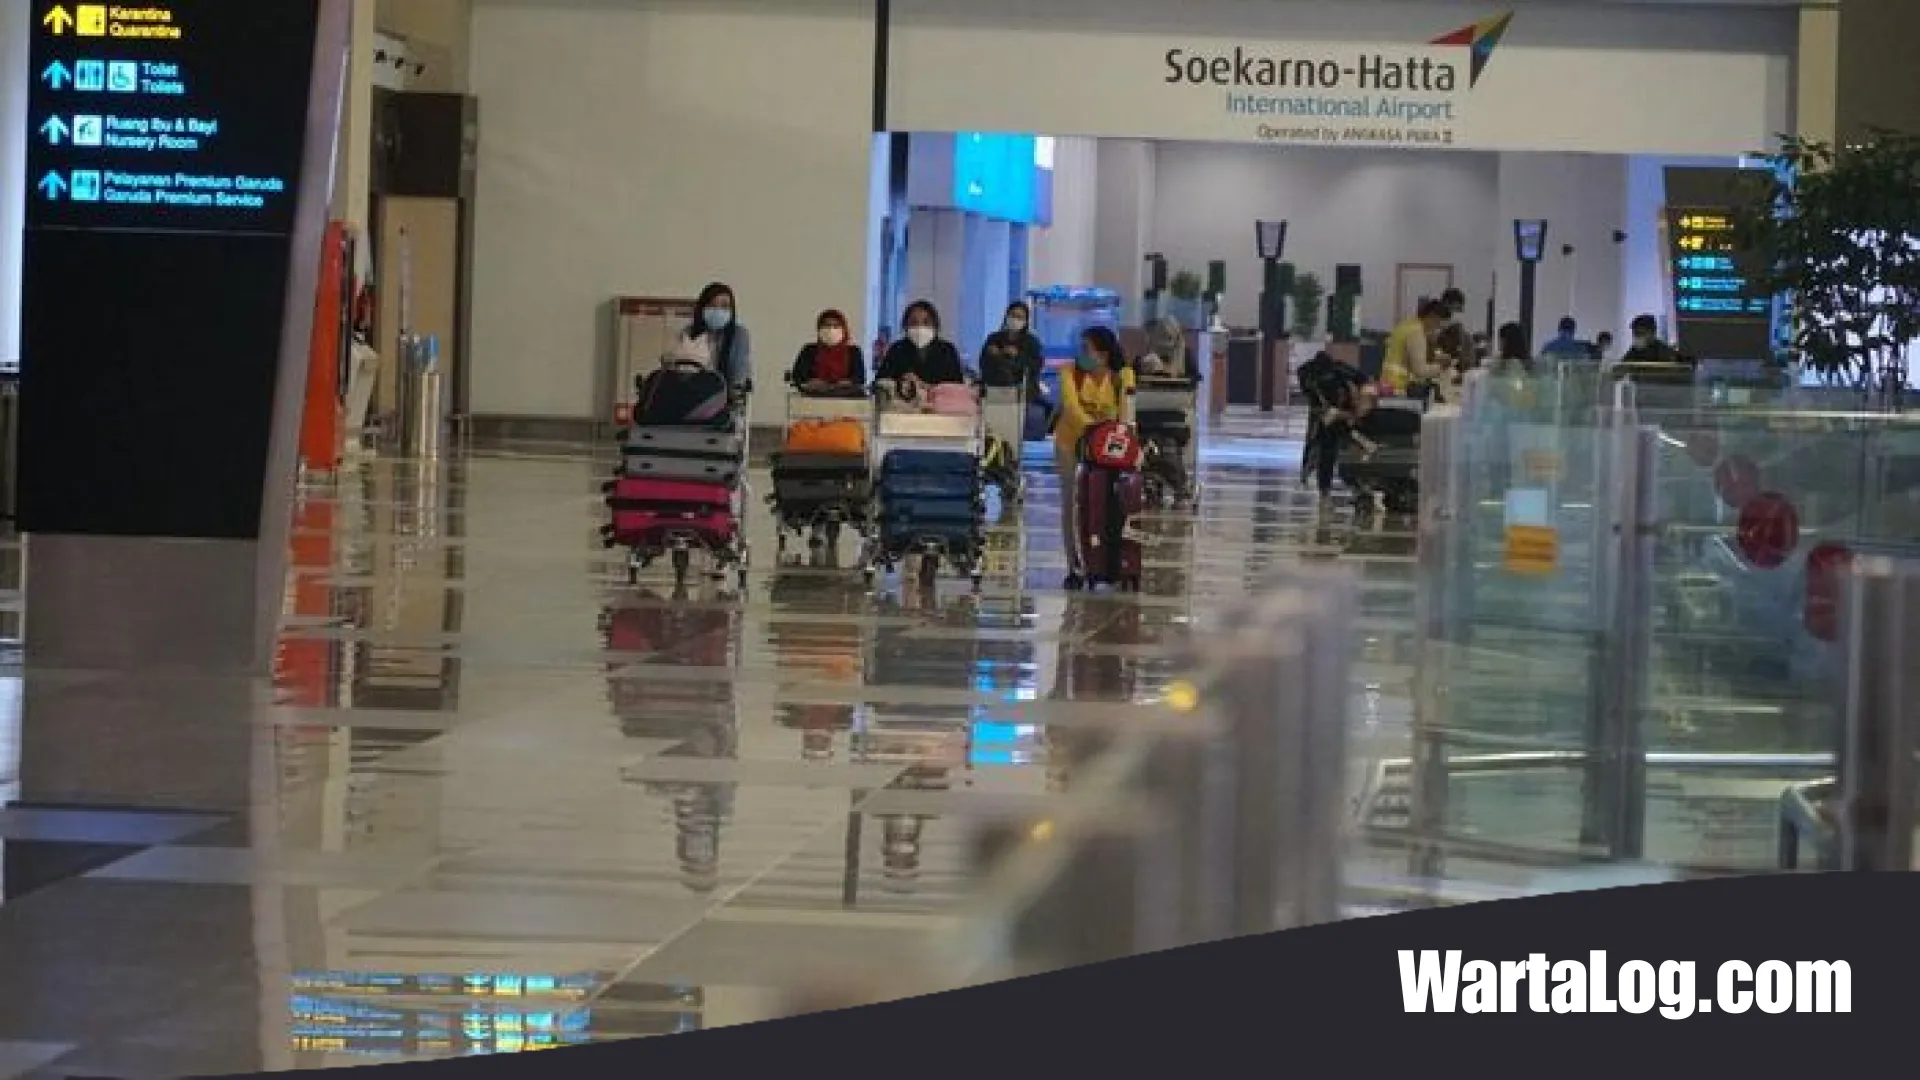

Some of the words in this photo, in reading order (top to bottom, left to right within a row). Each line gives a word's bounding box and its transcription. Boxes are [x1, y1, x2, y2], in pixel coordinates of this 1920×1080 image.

[142, 62, 178, 77] Toilet
[1165, 46, 1455, 91] Soekarno-Hatta
[141, 79, 184, 94] Toilets
[1226, 92, 1369, 118] International
[1376, 96, 1453, 123] Airport
[106, 115, 148, 133] Ruang
[1257, 125, 1320, 142] Operated
[1322, 126, 1339, 142] by
[105, 134, 156, 150] Nursery
[158, 134, 198, 149] Room
[175, 173, 231, 188] Premium
[156, 191, 212, 204] Premium
[216, 192, 264, 207] Service
